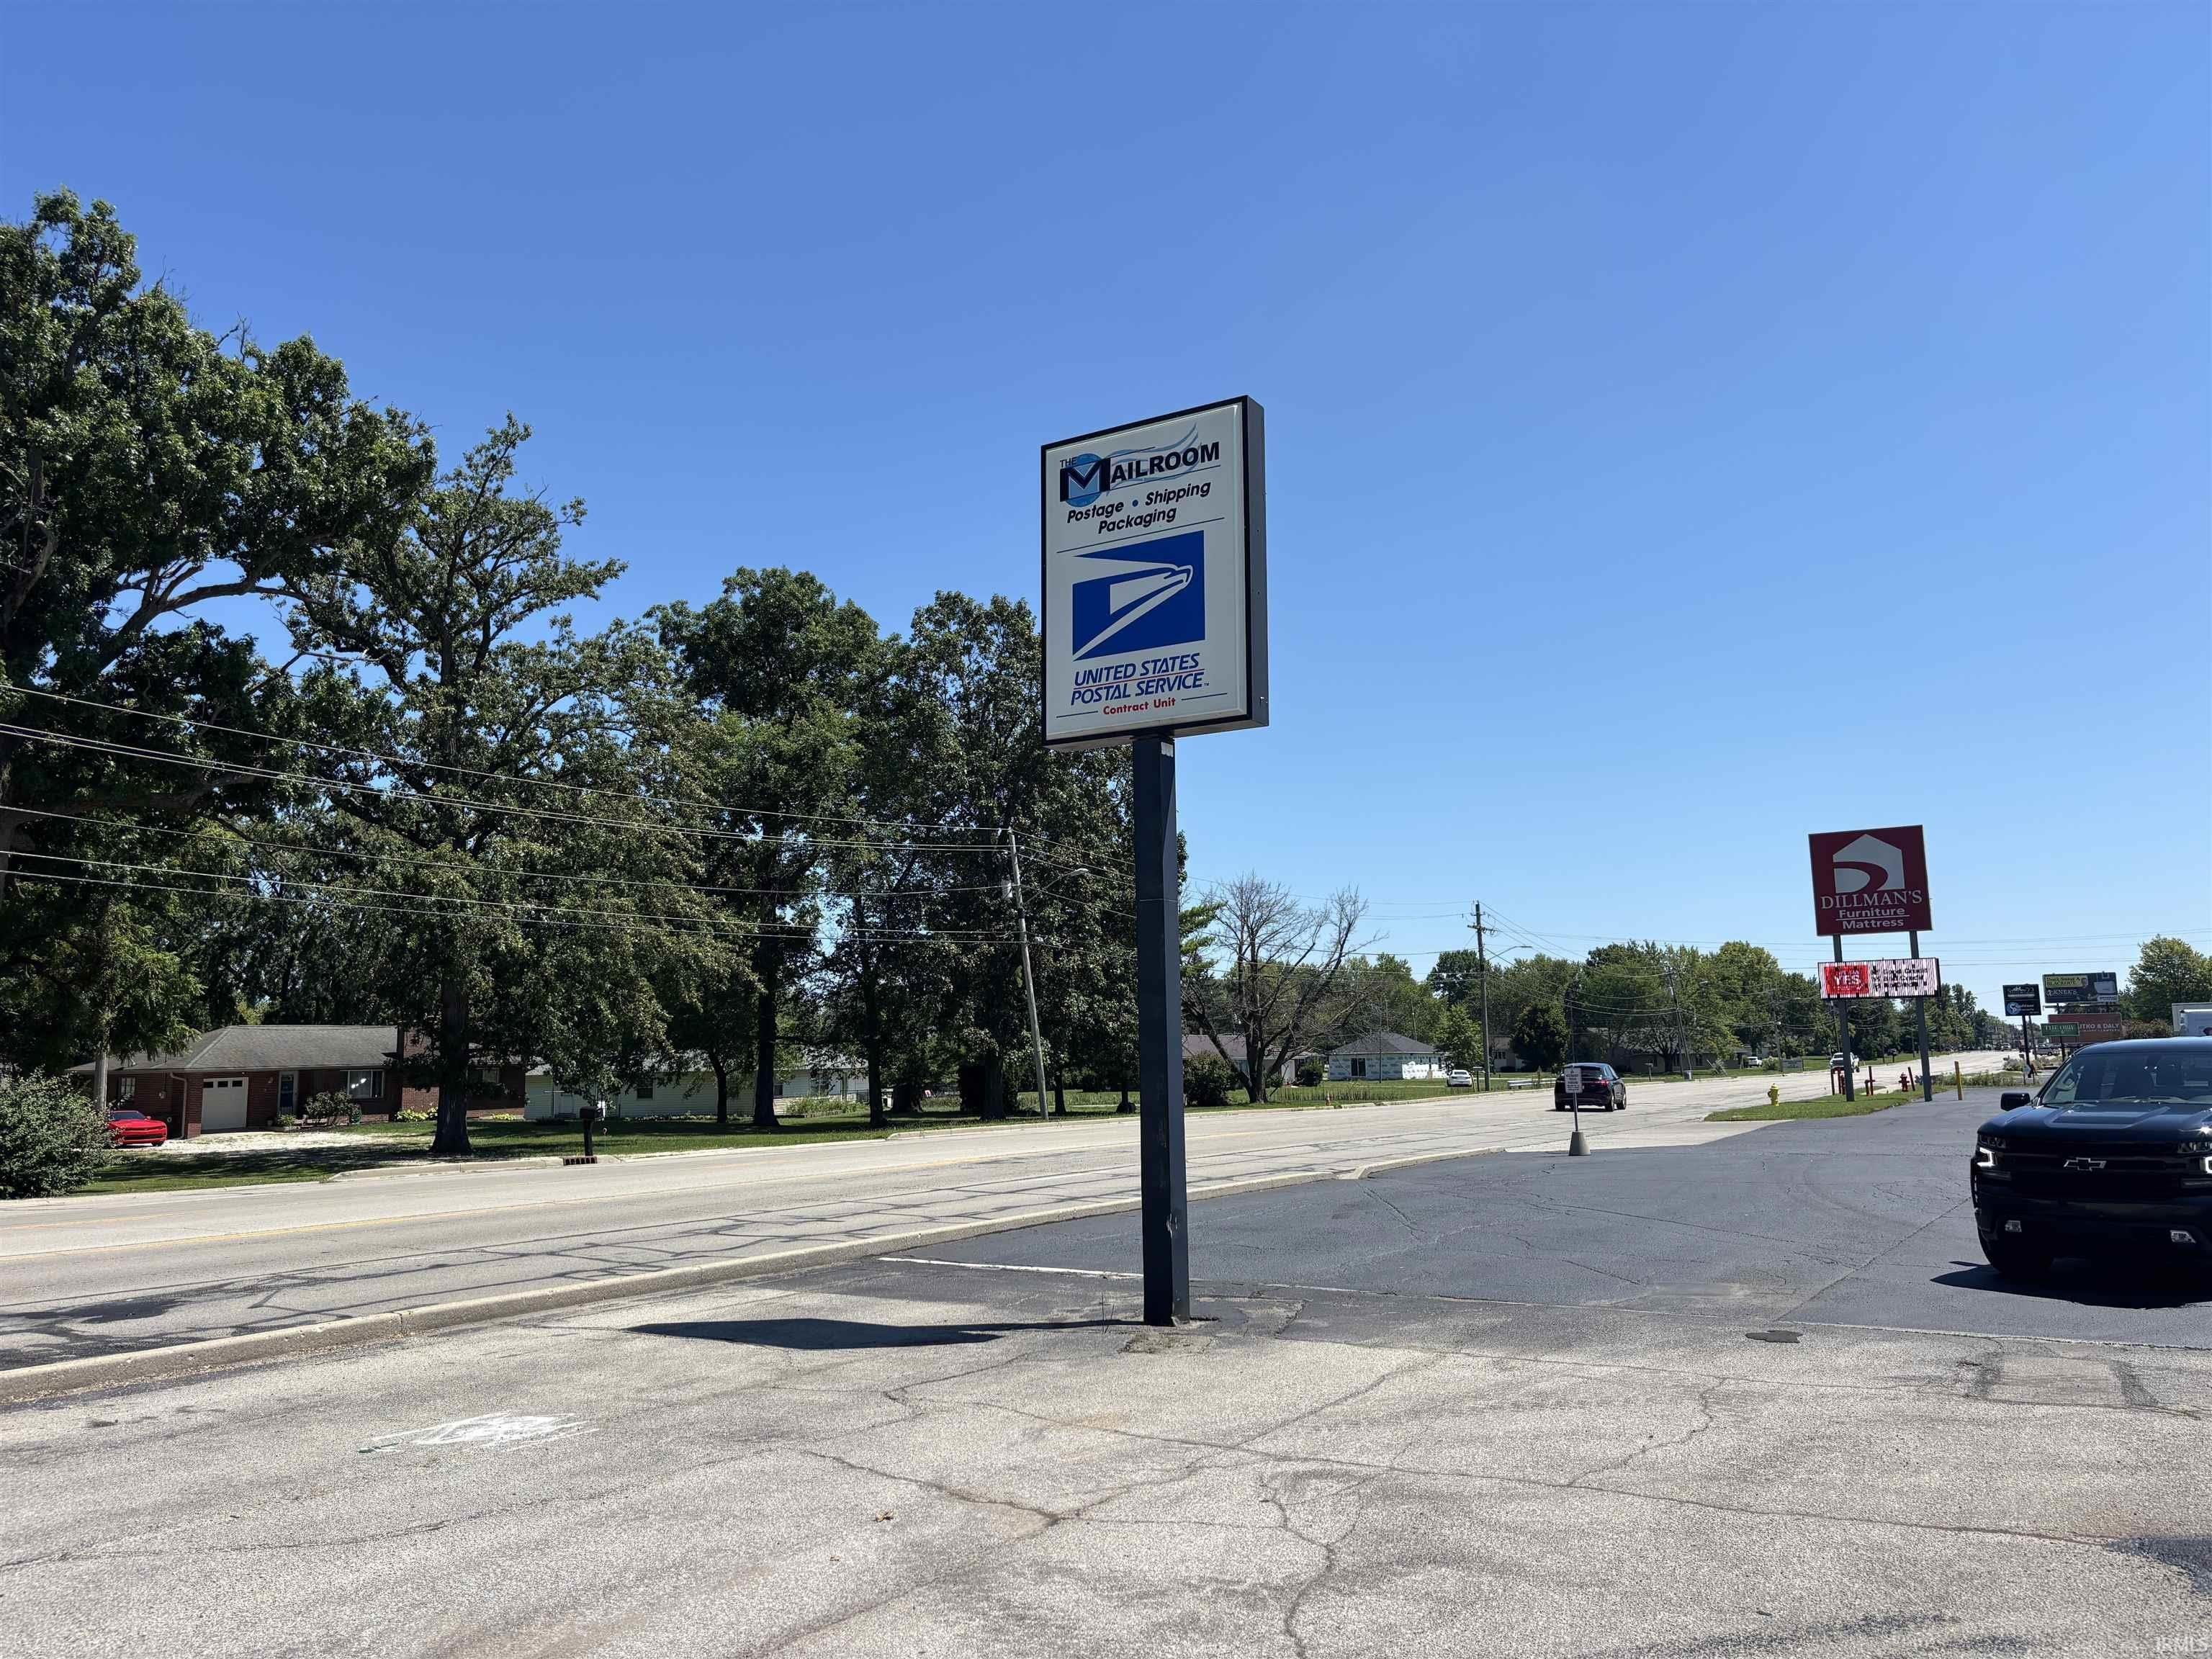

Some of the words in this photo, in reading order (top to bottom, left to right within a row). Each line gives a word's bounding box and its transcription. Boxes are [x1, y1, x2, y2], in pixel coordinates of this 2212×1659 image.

[1059, 441, 1220, 503] MAILROOM
[1060, 457, 1077, 468] THE
[1067, 500, 1124, 523] Postage
[1145, 482, 1211, 505] Shipping
[1098, 507, 1177, 534] Packaging
[1074, 662, 1136, 686] UNITED
[1140, 652, 1200, 676] STATES
[1071, 682, 1130, 706] POSTAL
[1135, 672, 1205, 696] SERVICE
[1103, 701, 1149, 715] Contract
[1154, 697, 1176, 708] Unit
[1820, 890, 1923, 909] DILLMAN'S
[1839, 907, 1905, 919] Furniture
[1843, 919, 1904, 930] Mattress
